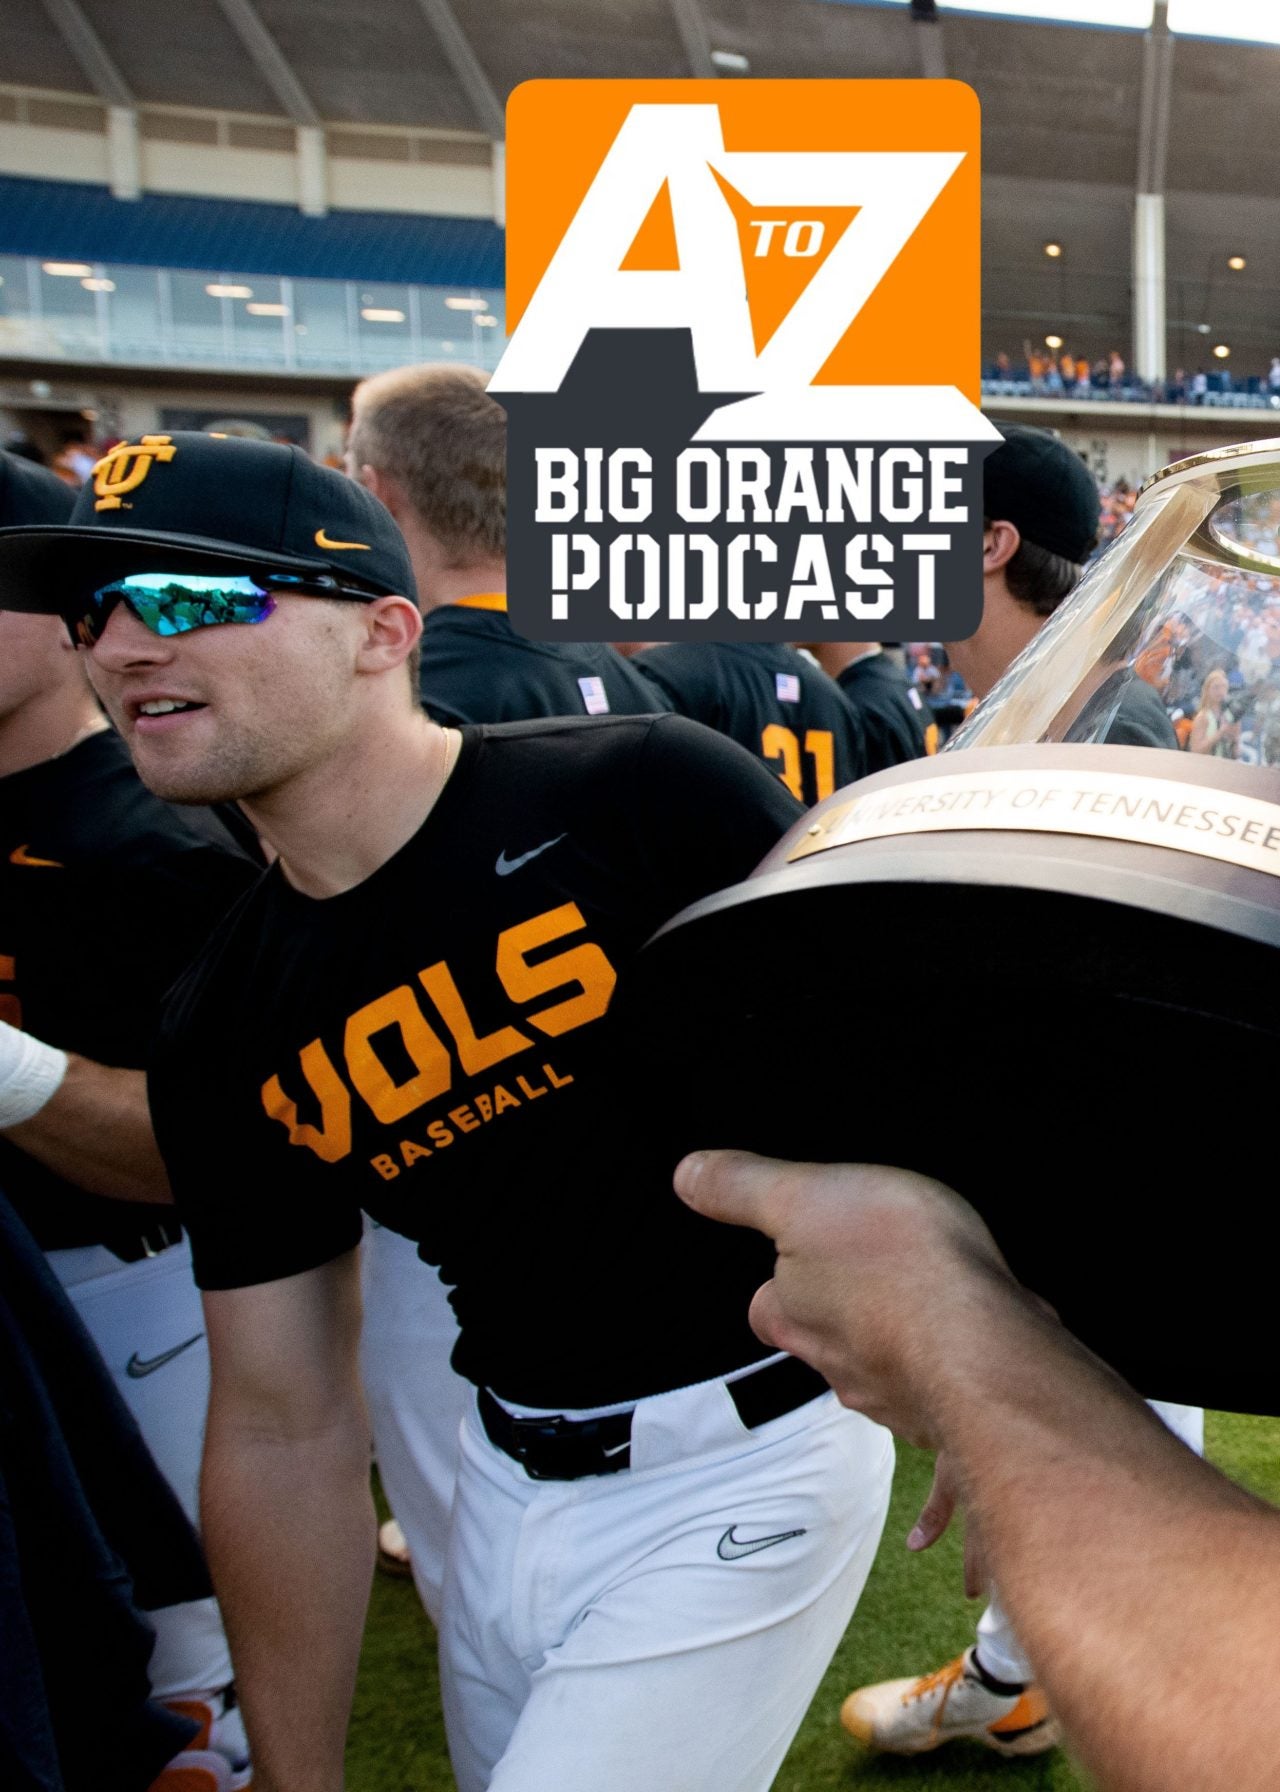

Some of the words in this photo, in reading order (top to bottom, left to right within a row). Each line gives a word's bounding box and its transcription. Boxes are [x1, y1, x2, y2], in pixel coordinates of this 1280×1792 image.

[1011, 787, 1057, 810] OF
[261, 900, 618, 1163] VOLS
[370, 1063, 575, 1181] BASEBALL
